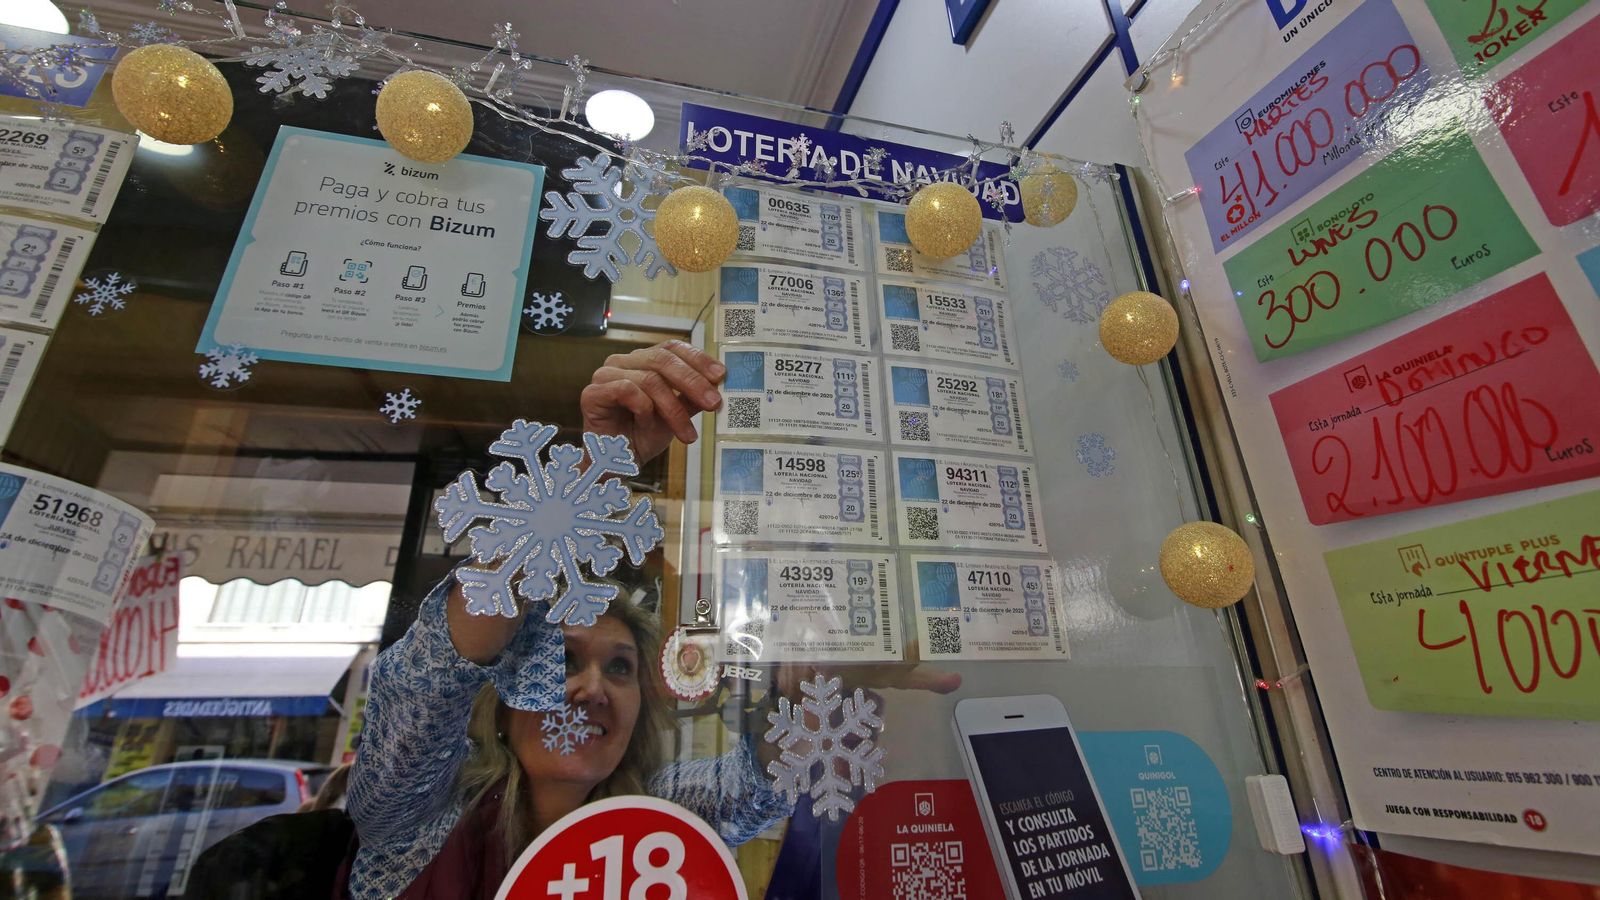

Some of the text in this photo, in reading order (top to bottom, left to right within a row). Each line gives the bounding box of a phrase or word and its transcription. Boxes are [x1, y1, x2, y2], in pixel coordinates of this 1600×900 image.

[1282, 26, 1299, 43] UN
[1474, 10, 1548, 66] JOKER
[1257, 60, 1328, 118] EUROMILLONES
[1243, 71, 1330, 145] MARTES
[401, 166, 439, 181] bizum
[840, 149, 882, 181] DE
[319, 176, 486, 214] Paga y cobra tus
[768, 197, 810, 214] 00635
[1317, 192, 1375, 232] BONOLOTO
[294, 200, 496, 239] premios con Bizum
[387, 241, 422, 252] funciona?
[1450, 243, 1492, 271] Euros
[272, 280, 290, 288] Paso
[769, 274, 814, 290] 77006
[333, 287, 366, 297] Paso #2
[926, 294, 966, 309] 15533
[457, 301, 486, 310] Premios
[774, 358, 822, 374] 85277
[1375, 345, 1452, 381] LA QUINIELA
[936, 376, 978, 393] 25292
[1329, 406, 1362, 430] jornada
[1545, 438, 1595, 463] Euros
[775, 457, 826, 473] 14598
[946, 467, 987, 483] 94311
[33, 493, 103, 527] 51968
[66, 518, 101, 534] NACIONAL
[28, 539, 71, 554] diciembre
[1520, 535, 1561, 551] PLUS
[224, 535, 346, 571] RAFAEL
[779, 566, 834, 582] 43939
[967, 570, 1011, 586] 47110
[1370, 584, 1434, 606] Esta jornada
[1138, 771, 1176, 781] QUINIGOL
[1373, 767, 1401, 779] CENTRO
[1403, 769, 1413, 779] DE
[1414, 767, 1452, 780] ATENCIÓN
[1453, 771, 1465, 781] AL
[1465, 771, 1506, 783] USUARIO:
[1506, 772, 1523, 783] 915
[1543, 773, 1563, 785] 300
[999, 796, 1033, 816] ESCANEA
[1034, 795, 1045, 809] EL
[1385, 804, 1518, 824] JUEGA CON RESPONSABILIDAD
[896, 823, 954, 834] LA QUINIELA
[1005, 807, 1077, 836] Y CONSULTA
[1013, 825, 1095, 857] LOS PARTIDOS
[547, 831, 688, 900] +18
[1020, 843, 1111, 878] DE LA JORNADA
[1028, 866, 1104, 899] EN TU MÓVIL
